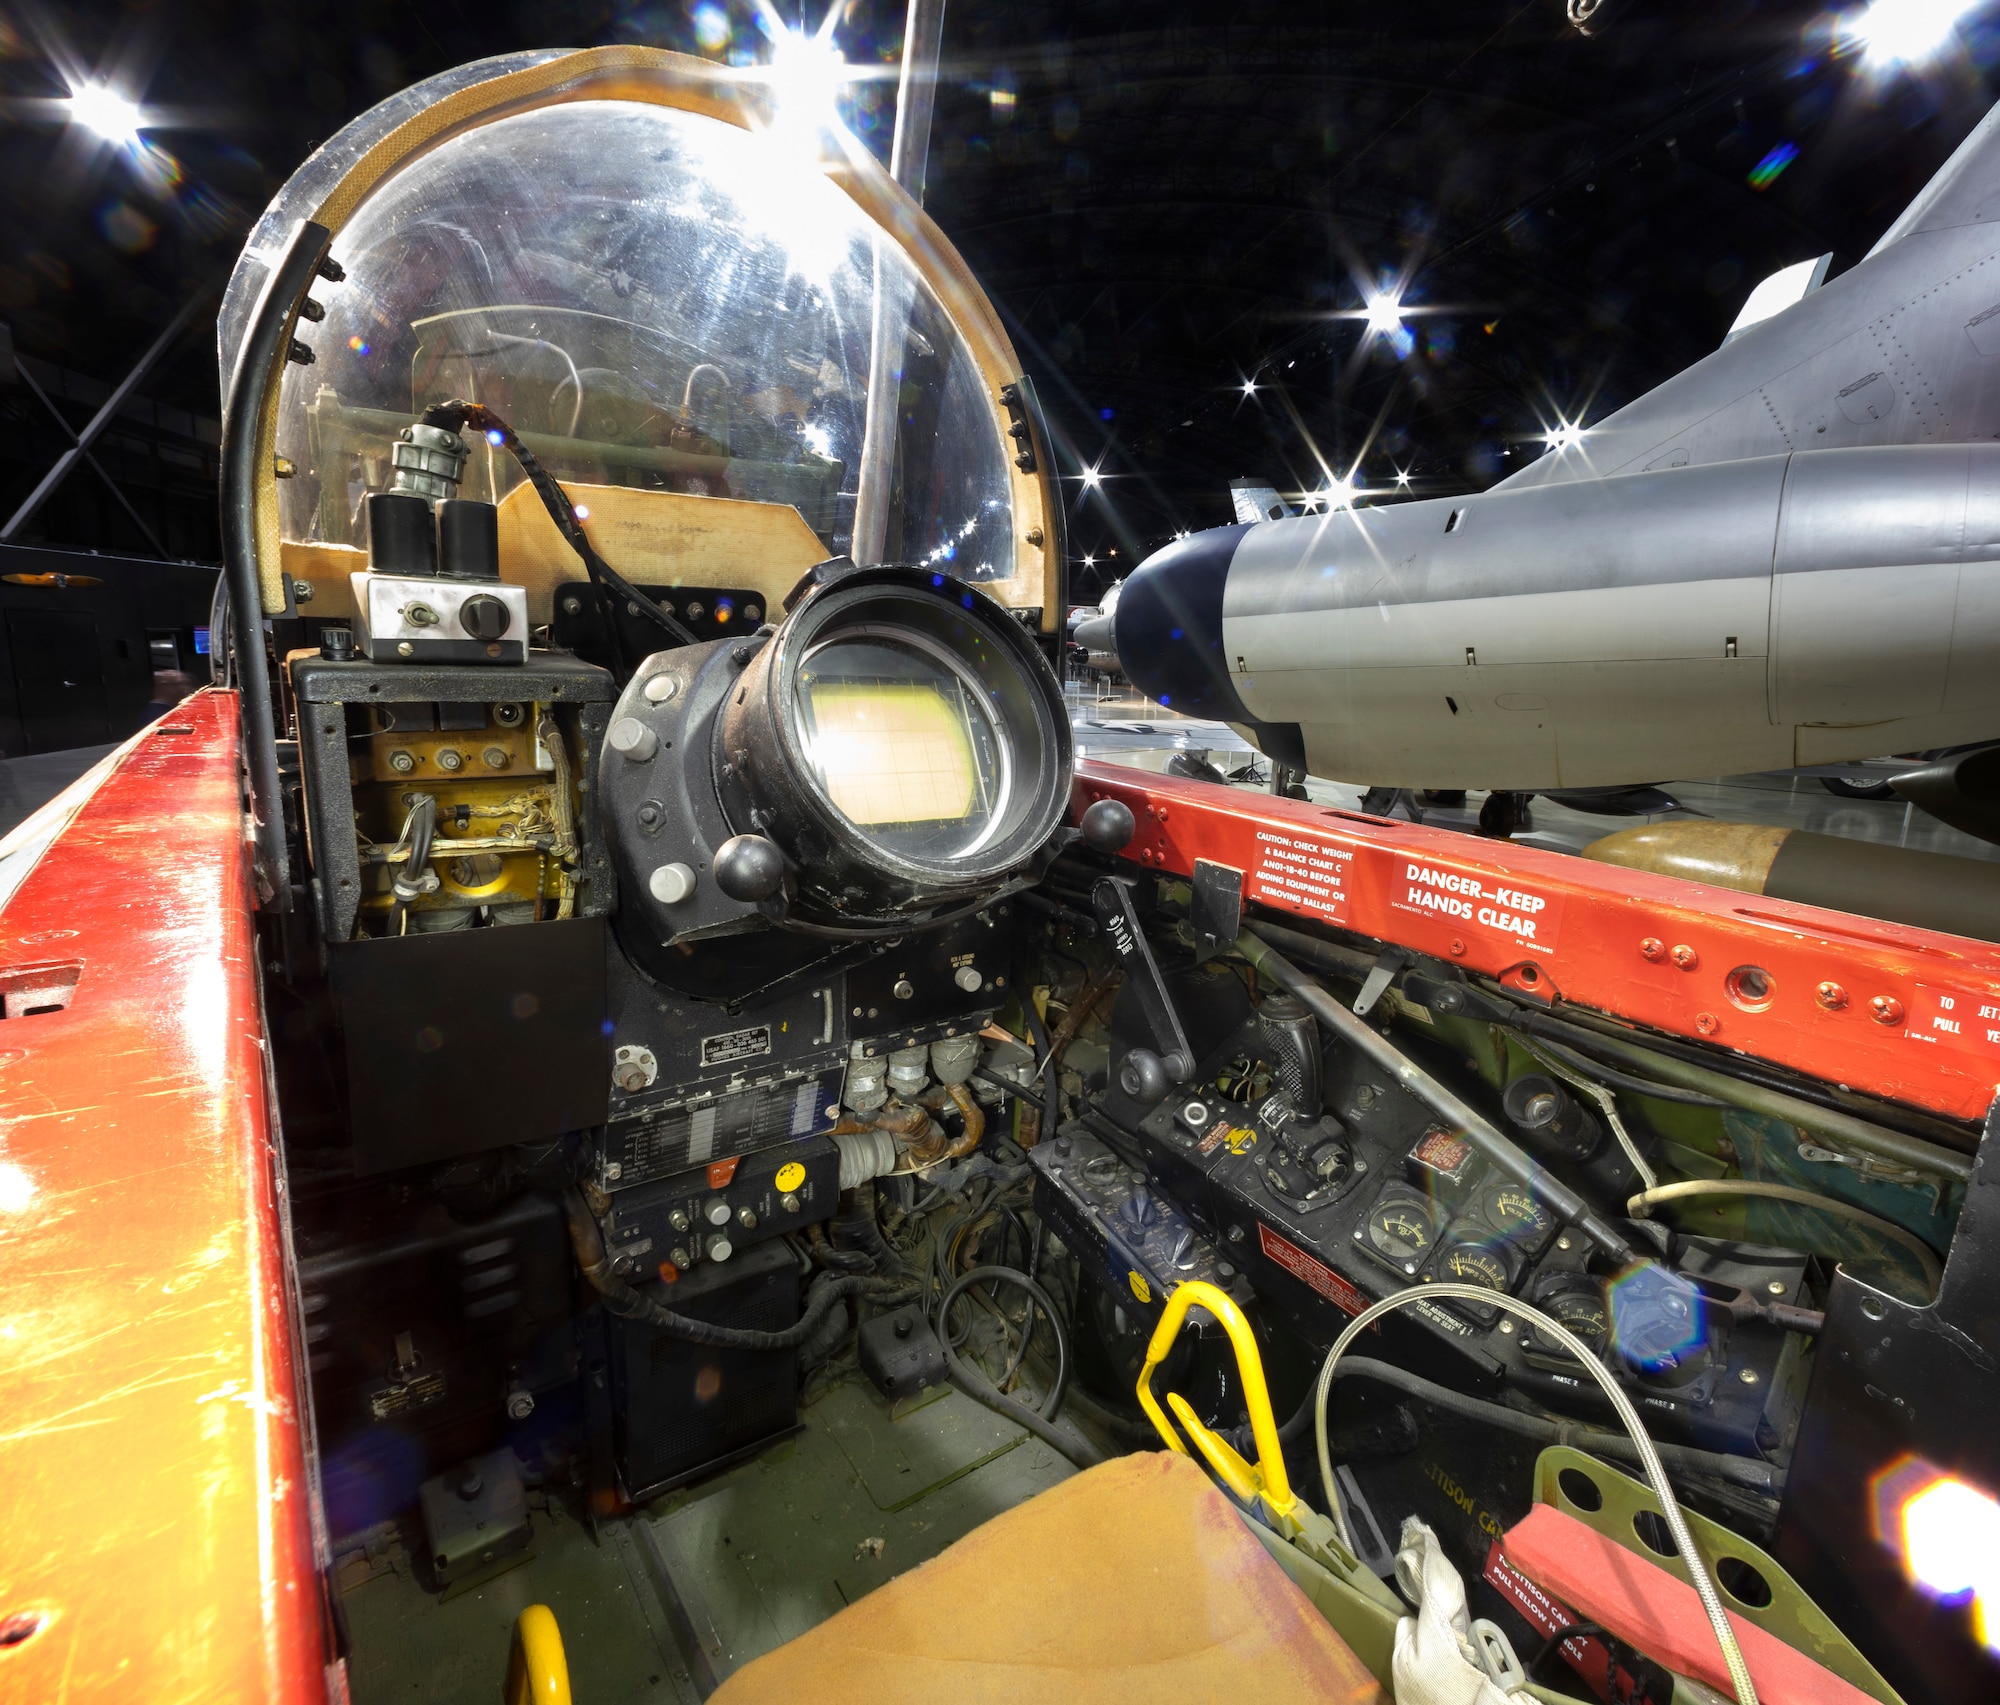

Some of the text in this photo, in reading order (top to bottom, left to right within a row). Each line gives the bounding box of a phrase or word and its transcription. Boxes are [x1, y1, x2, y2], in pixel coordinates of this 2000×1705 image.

[1257, 832, 1353, 861] CAUTION: CHECK WEIGHT
[1265, 847, 1341, 872] & BALANCE CHART C
[1256, 870, 1345, 901] ADDING EQUIPMENT OR
[1310, 871, 1341, 886] BEFORE
[1261, 885, 1335, 913] REMOVING BALLAST
[1391, 902, 1422, 914] SACRAMENTO
[1408, 887, 1537, 939] HANDS CLEAR
[1940, 996, 1955, 1010] TO
[1933, 1017, 1961, 1034] PULL
[1507, 1206, 1522, 1218] VOLTS
[1398, 1225, 1412, 1236] VOLT
[1461, 1264, 1479, 1278] AMPS
[1416, 1305, 1457, 1332] LEVER ON SEAT
[1417, 1298, 1464, 1329] SEAT ADJUSTMENT
[1552, 1374, 1579, 1387] PHASE 2
[1645, 1397, 1675, 1410] PHASE 3
[1493, 1566, 1512, 1588] PULL
[1514, 1586, 1547, 1622] YELLOW
